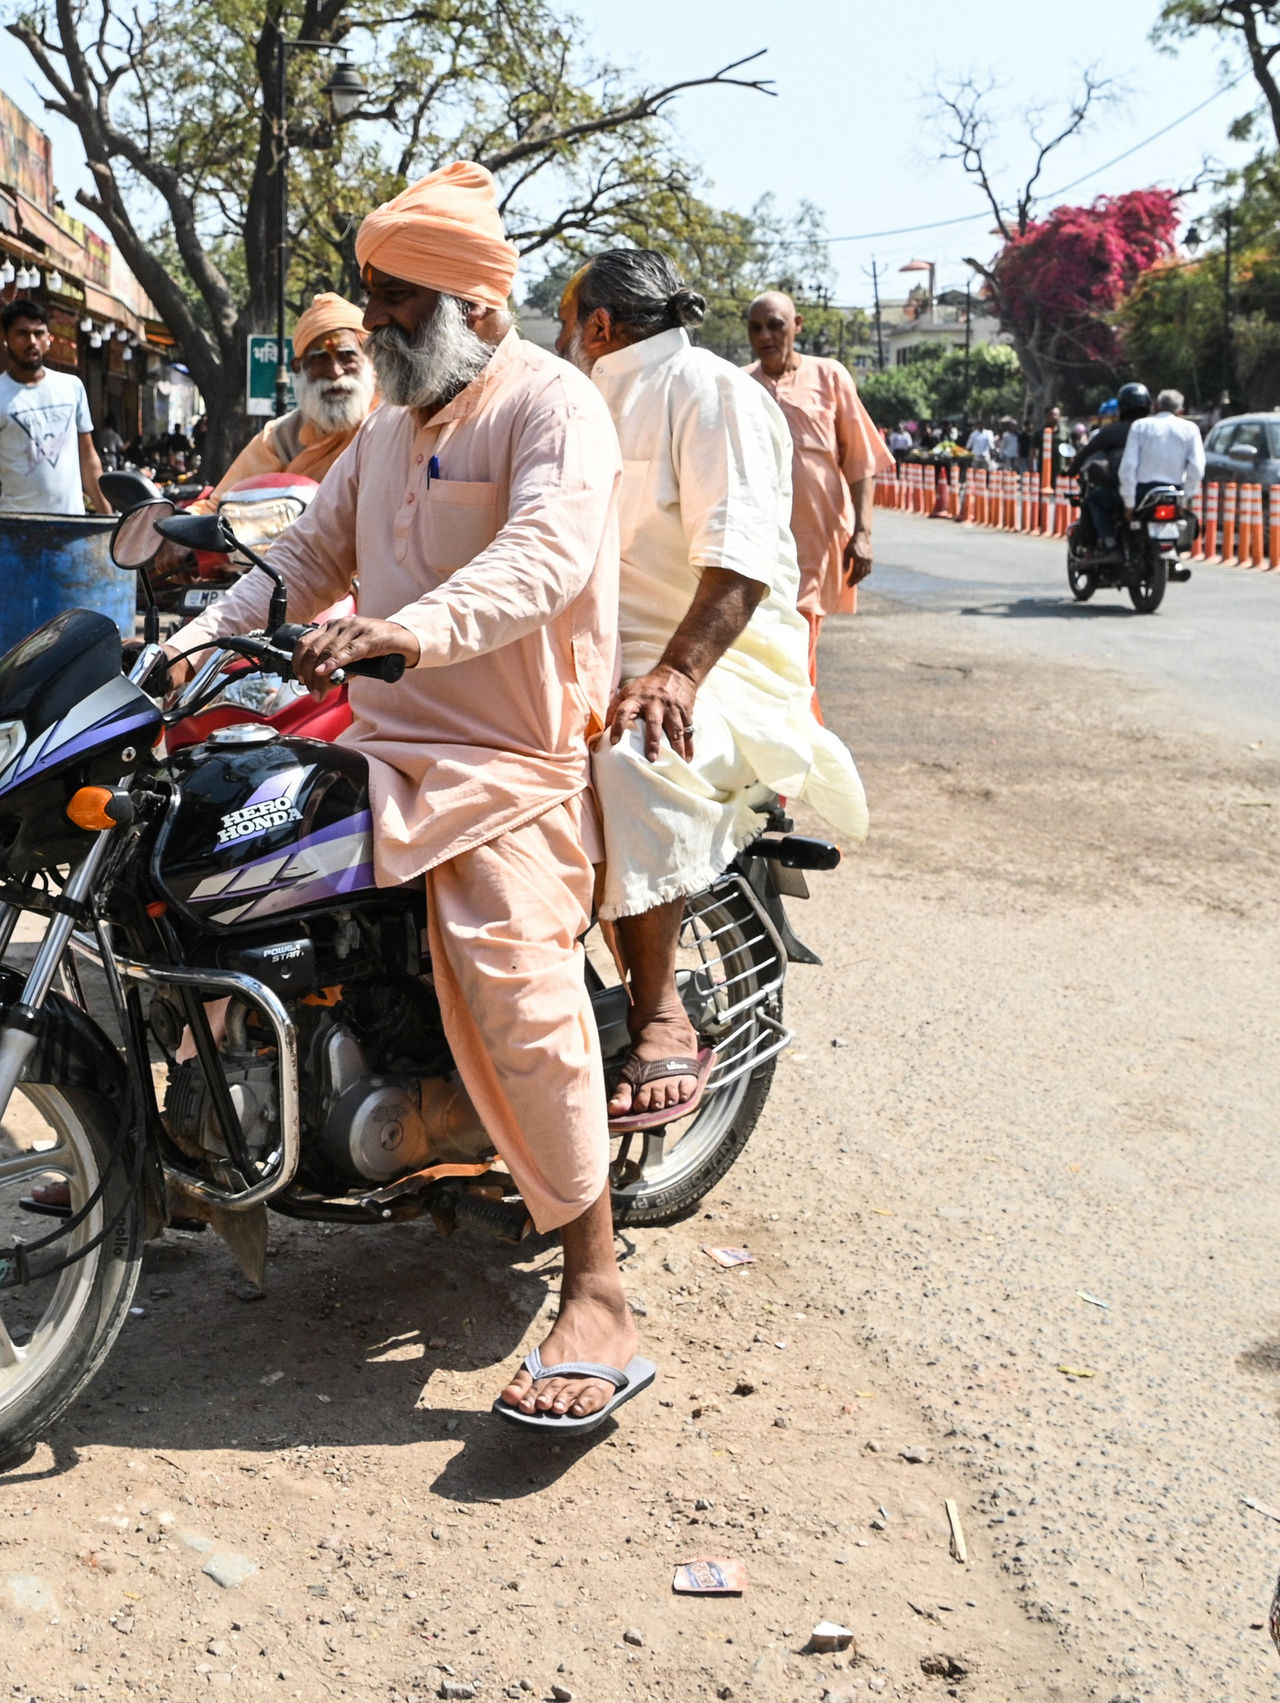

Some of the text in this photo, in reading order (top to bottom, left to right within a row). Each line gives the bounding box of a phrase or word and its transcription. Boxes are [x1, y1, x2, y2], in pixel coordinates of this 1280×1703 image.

[200, 591, 219, 605] MP
[217, 808, 303, 843] HONDA
[221, 796, 292, 828] HERO
